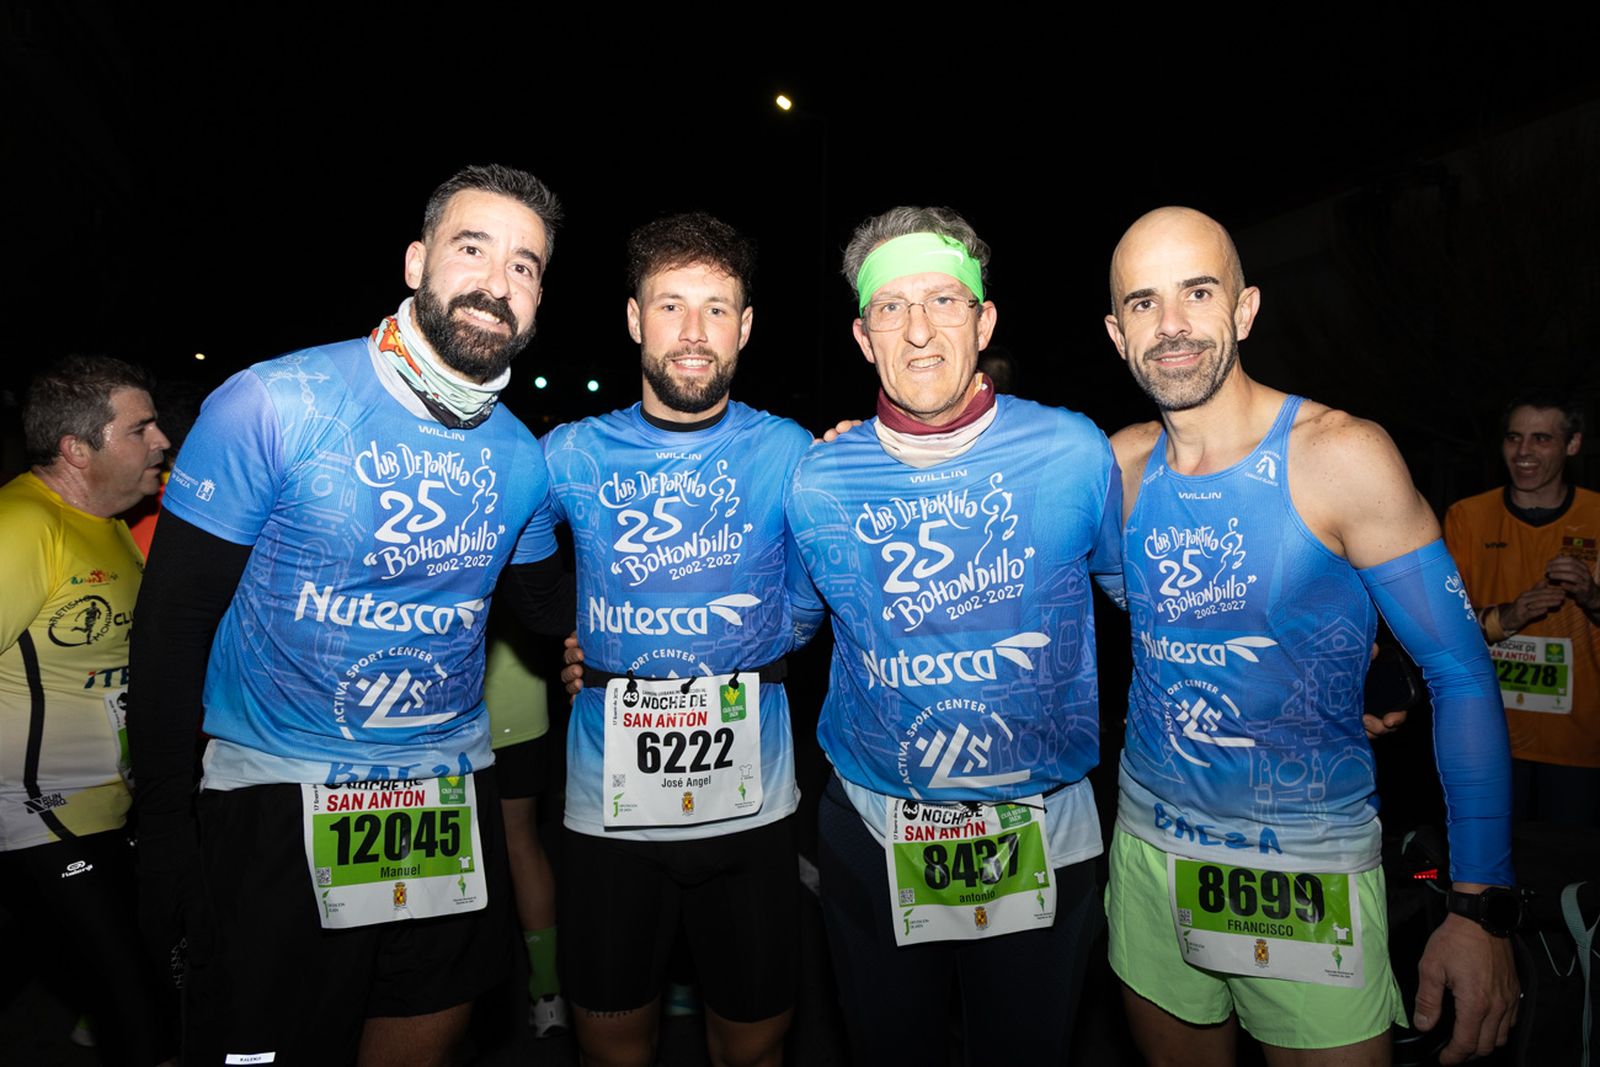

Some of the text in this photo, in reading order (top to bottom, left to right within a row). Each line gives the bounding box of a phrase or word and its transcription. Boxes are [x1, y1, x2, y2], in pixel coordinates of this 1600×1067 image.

[418, 425, 465, 442] WILLIN
[655, 452, 702, 460] WILLIN
[910, 469, 968, 484] WILLIN
[1178, 491, 1222, 500] WILLIN
[374, 479, 447, 545] 25
[613, 496, 683, 553] 25
[426, 554, 494, 577] 2002-2027
[669, 553, 742, 580] 2002-2027
[881, 519, 955, 593] 25
[1158, 549, 1203, 597] 25
[294, 581, 455, 635] Nutesca
[945, 584, 1025, 621] 2002-2027
[1194, 600, 1247, 620] 2002-2027
[589, 596, 709, 636] Nutesca
[652, 648, 696, 664] CENTER
[1140, 631, 1227, 667] Nutesca
[863, 648, 998, 690] Nutesca
[333, 646, 433, 724] ACTIVA SPORT CENTER
[623, 691, 640, 703] 43
[1167, 681, 1183, 696] ORT
[640, 694, 708, 710] NOCHE DE
[623, 713, 653, 728] SAN
[655, 708, 708, 728] ANTÓN
[636, 727, 735, 775] 6222
[898, 698, 987, 785] ACTIVA SPORT CENTER
[661, 775, 712, 790] José Angel
[326, 792, 365, 812] SAN
[368, 787, 426, 810] ANTÓN
[329, 810, 461, 866] 12045
[905, 825, 936, 842] SAN
[380, 864, 421, 879] Manuel
[923, 832, 1021, 891] 8437
[959, 888, 996, 904] antonio
[1197, 864, 1326, 925] 8699
[1227, 919, 1294, 938] FRANCISCO
